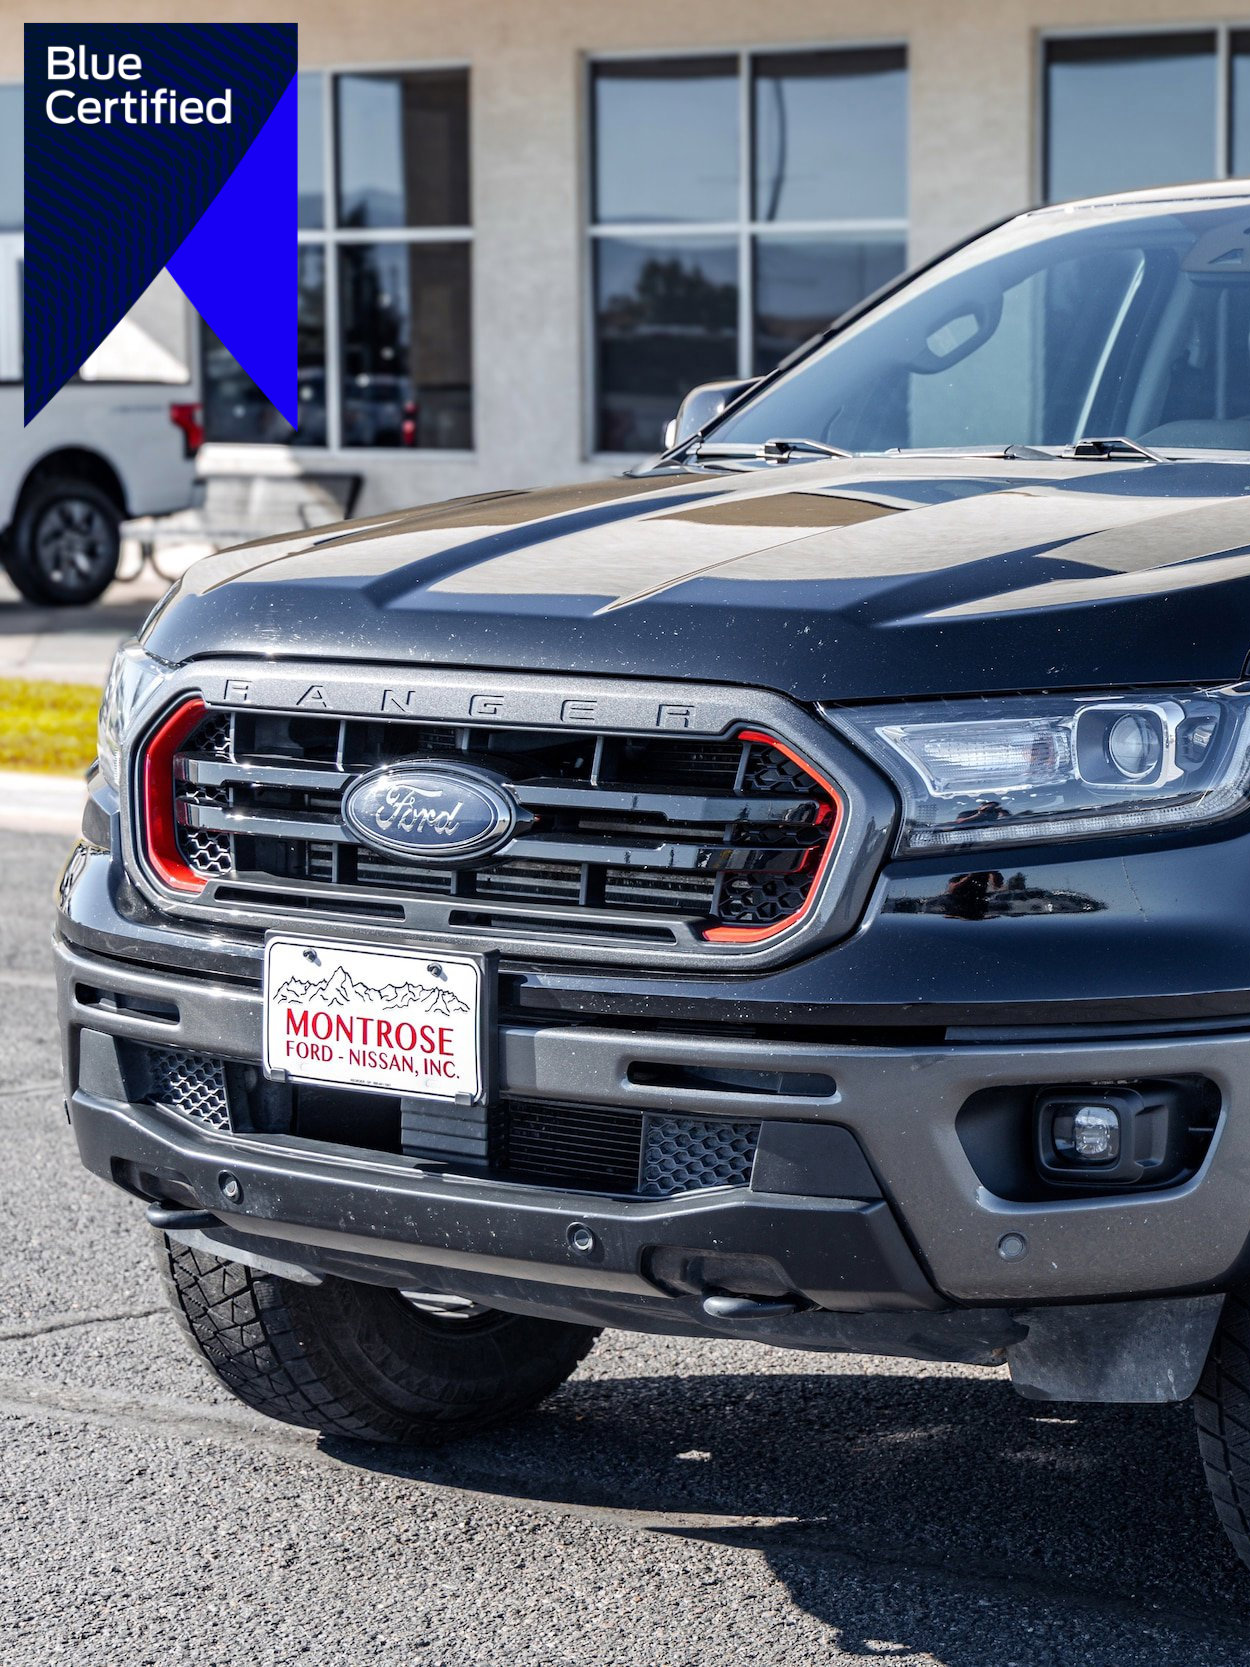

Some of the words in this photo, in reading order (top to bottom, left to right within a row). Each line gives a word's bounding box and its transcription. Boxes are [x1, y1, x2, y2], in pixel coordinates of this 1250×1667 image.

[224, 679, 697, 730] RANGER
[375, 783, 462, 836] Ford
[286, 1008, 455, 1056] MONTROSE
[286, 1040, 333, 1062] FORD
[349, 1049, 419, 1077] NISSAN,
[424, 1058, 460, 1080] INC.
